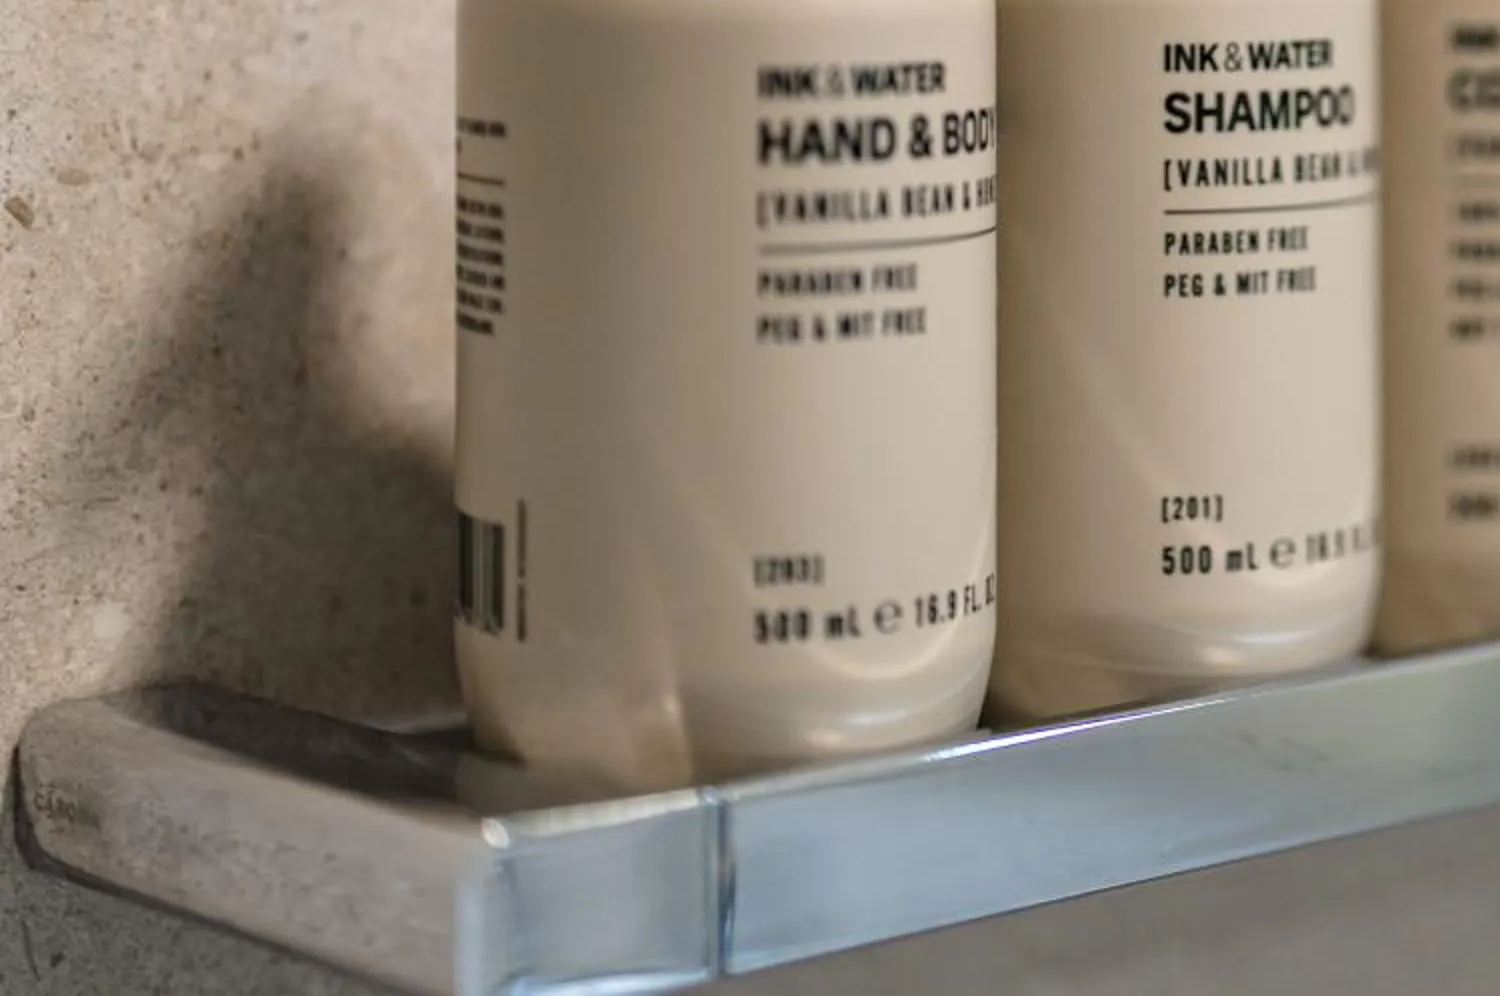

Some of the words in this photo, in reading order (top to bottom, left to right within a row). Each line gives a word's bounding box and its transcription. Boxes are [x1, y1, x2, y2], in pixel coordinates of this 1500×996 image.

[1164, 83, 1354, 134] SHAMPOO
[758, 117, 897, 165] HAND
[909, 115, 934, 159] &
[1164, 230, 1260, 256] PARABEN
[1267, 226, 1309, 251] FREE
[1164, 272, 1204, 298] PEG
[1214, 272, 1227, 296] &
[1236, 270, 1269, 295] MIT
[1277, 266, 1316, 292] FREE
[1161, 494, 1223, 523] [201]
[1161, 544, 1213, 575] 500
